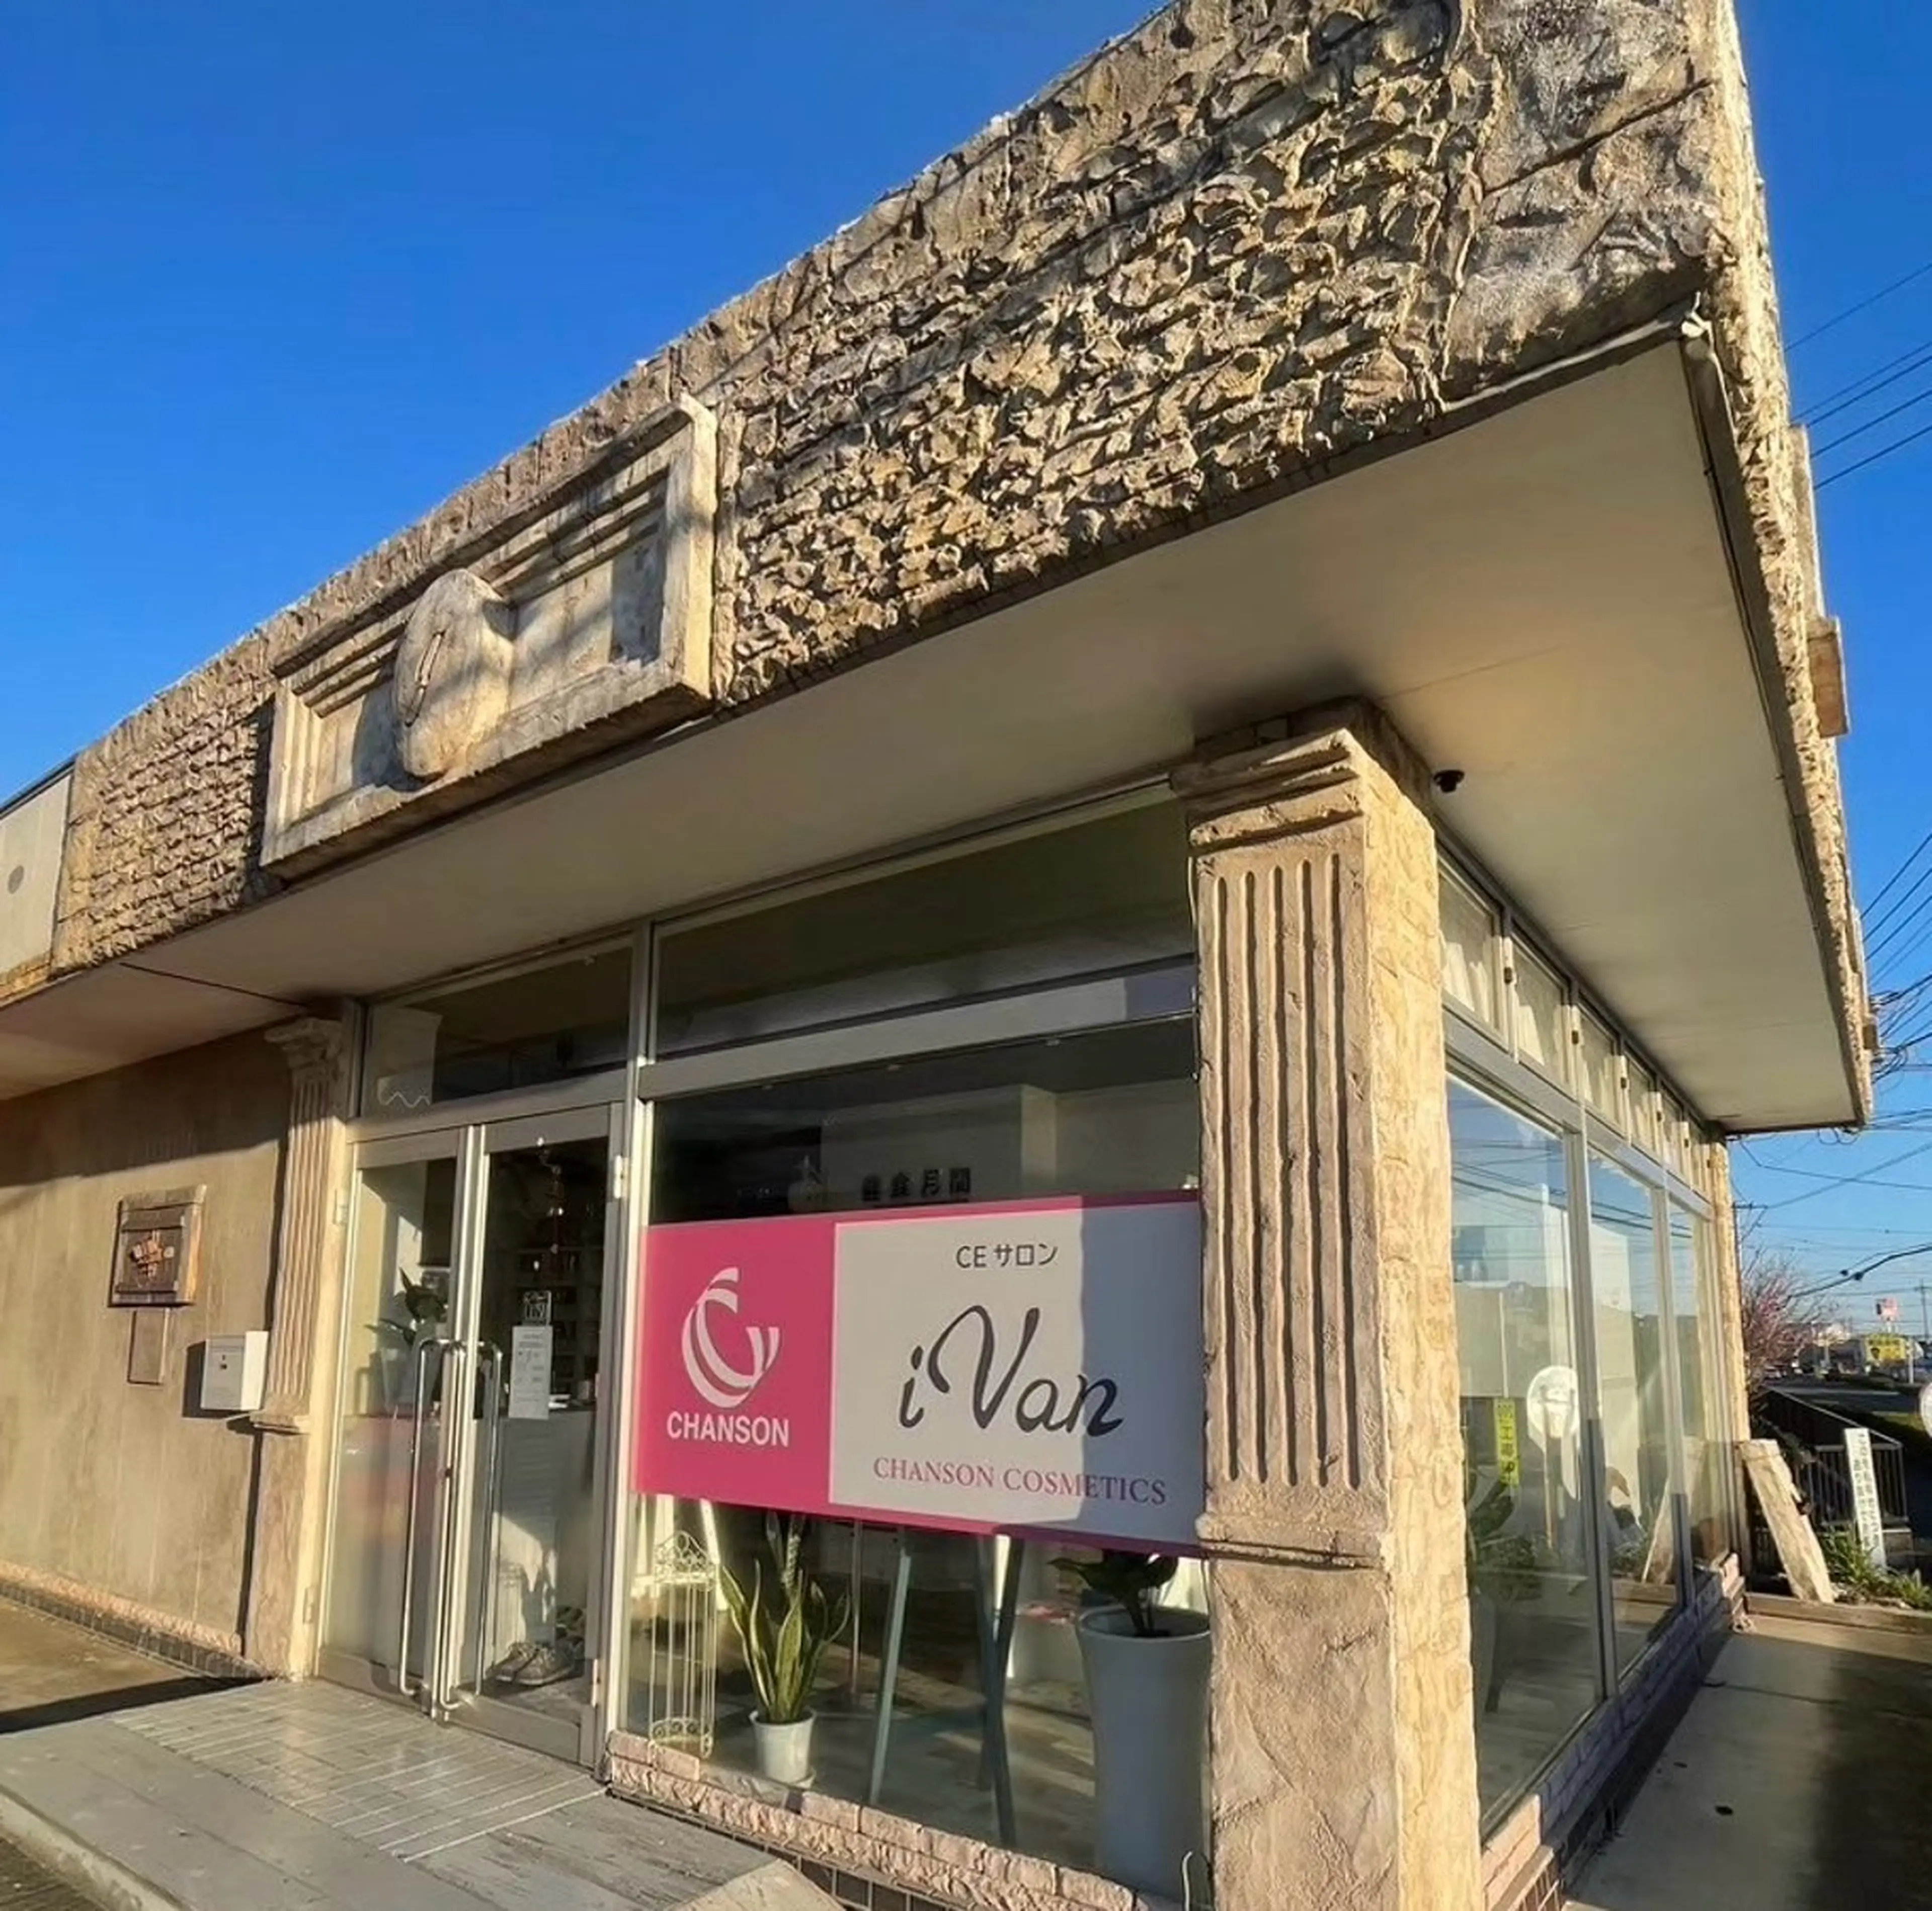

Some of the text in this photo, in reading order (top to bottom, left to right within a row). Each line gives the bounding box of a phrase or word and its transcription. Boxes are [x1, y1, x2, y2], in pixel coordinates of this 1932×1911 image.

[956, 1243, 1058, 1268] CE サロン
[900, 1305, 1124, 1437] iVan
[666, 1410, 789, 1447] CHANSON
[873, 1457, 1166, 1505] CHANSON COSMETICS
